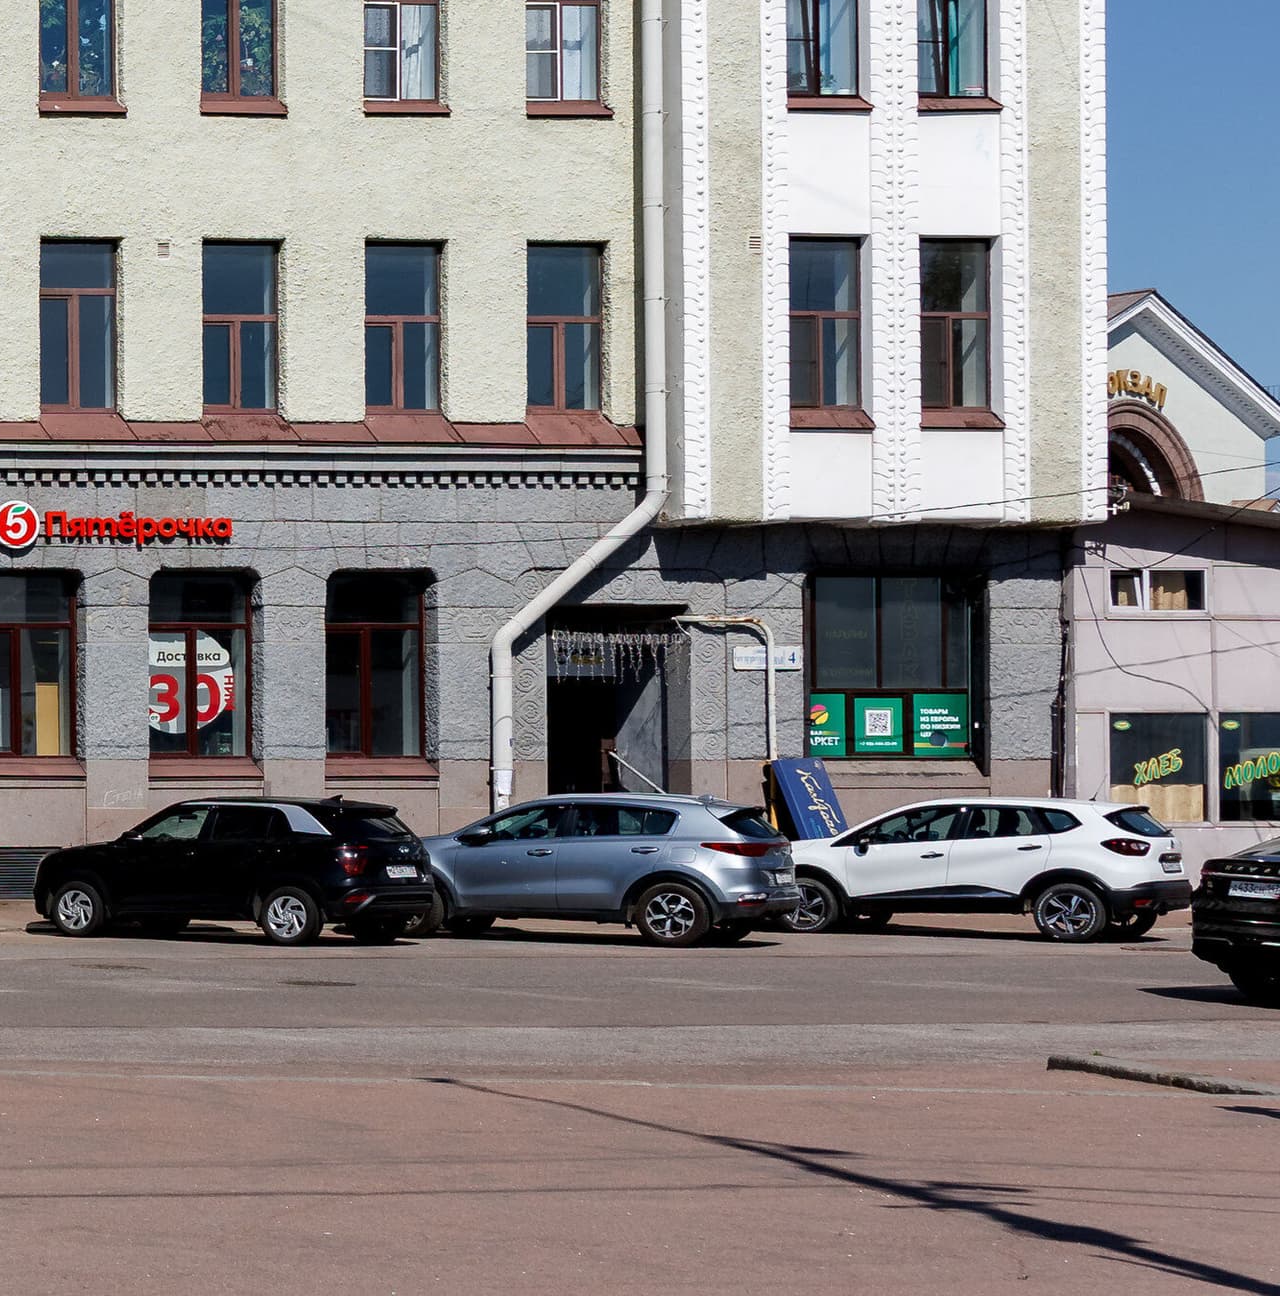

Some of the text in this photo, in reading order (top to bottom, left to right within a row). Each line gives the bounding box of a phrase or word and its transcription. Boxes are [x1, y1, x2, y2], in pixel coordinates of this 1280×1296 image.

[1107, 369, 1168, 407] ОКЗАЛ
[44, 511, 233, 544] Пятёрочка
[156, 651, 221, 663] Доствка
[787, 651, 796, 664] 4
[148, 673, 221, 723] 30
[1133, 748, 1184, 786] ХЛЕБ
